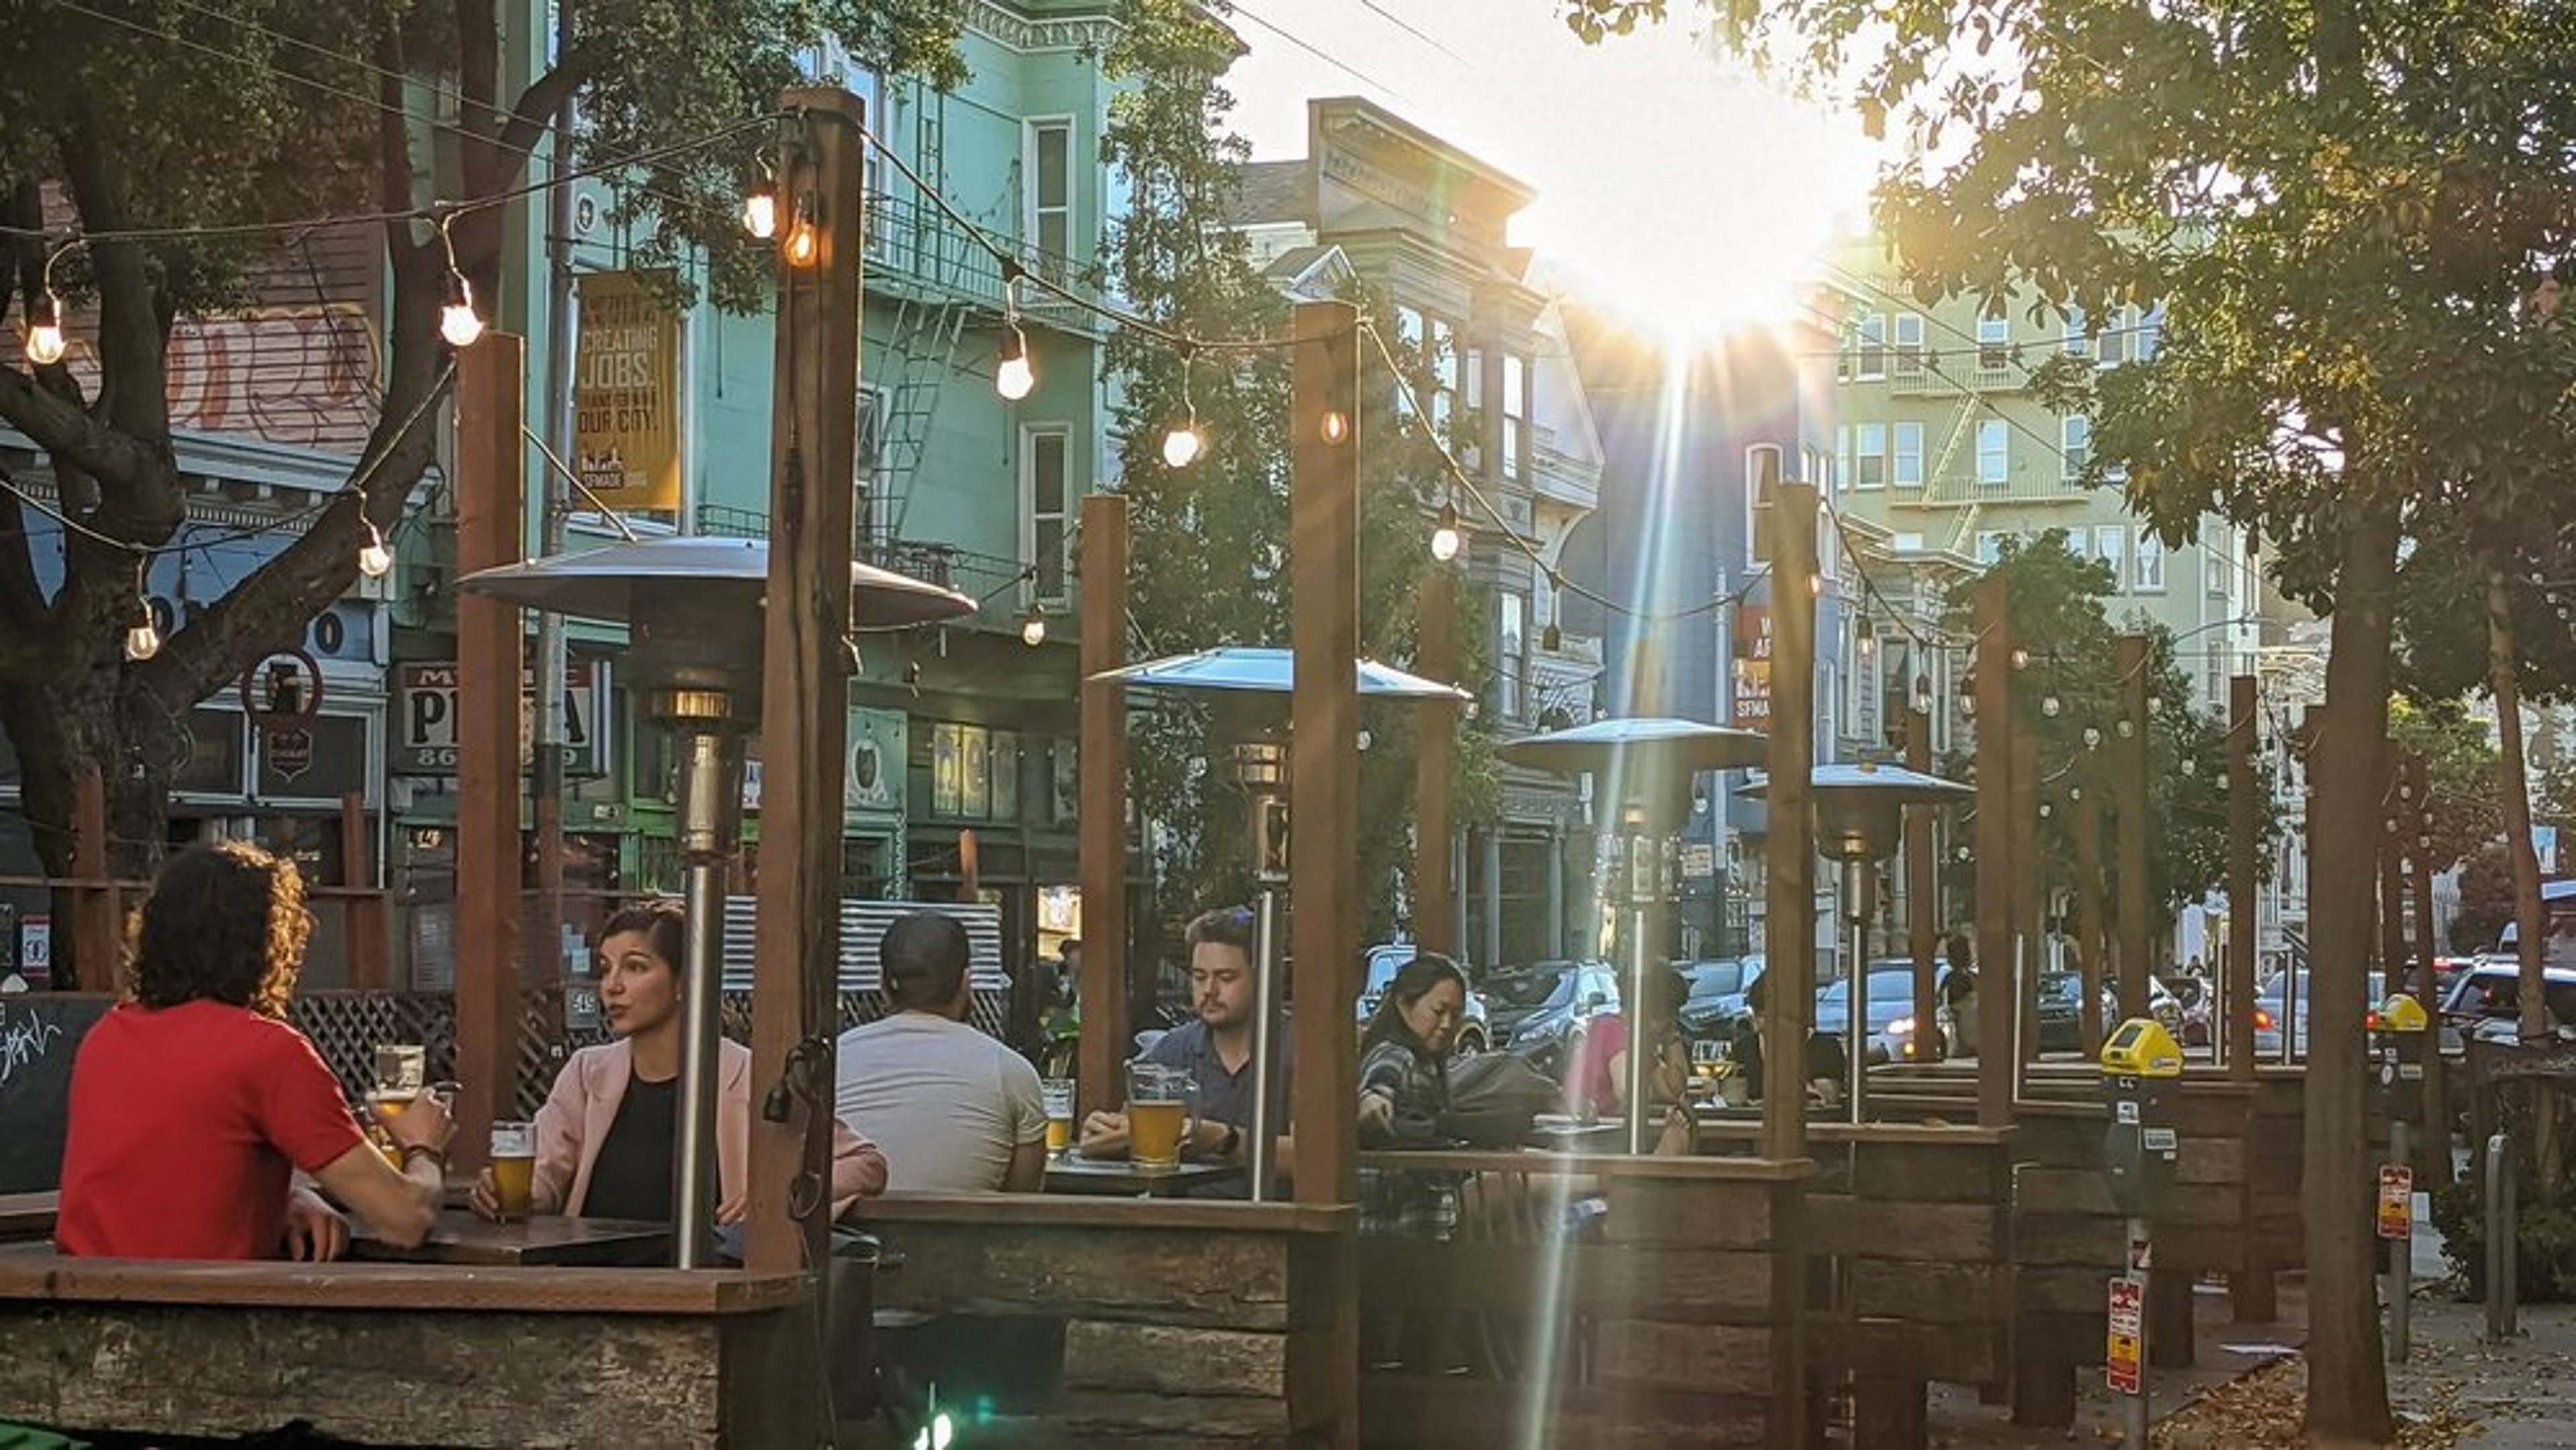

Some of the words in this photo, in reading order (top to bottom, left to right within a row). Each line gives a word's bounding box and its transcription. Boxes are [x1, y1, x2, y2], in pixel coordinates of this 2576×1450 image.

[581, 327, 658, 354] CREATING
[580, 353, 655, 390] JOBS.
[578, 412, 611, 433] OUR
